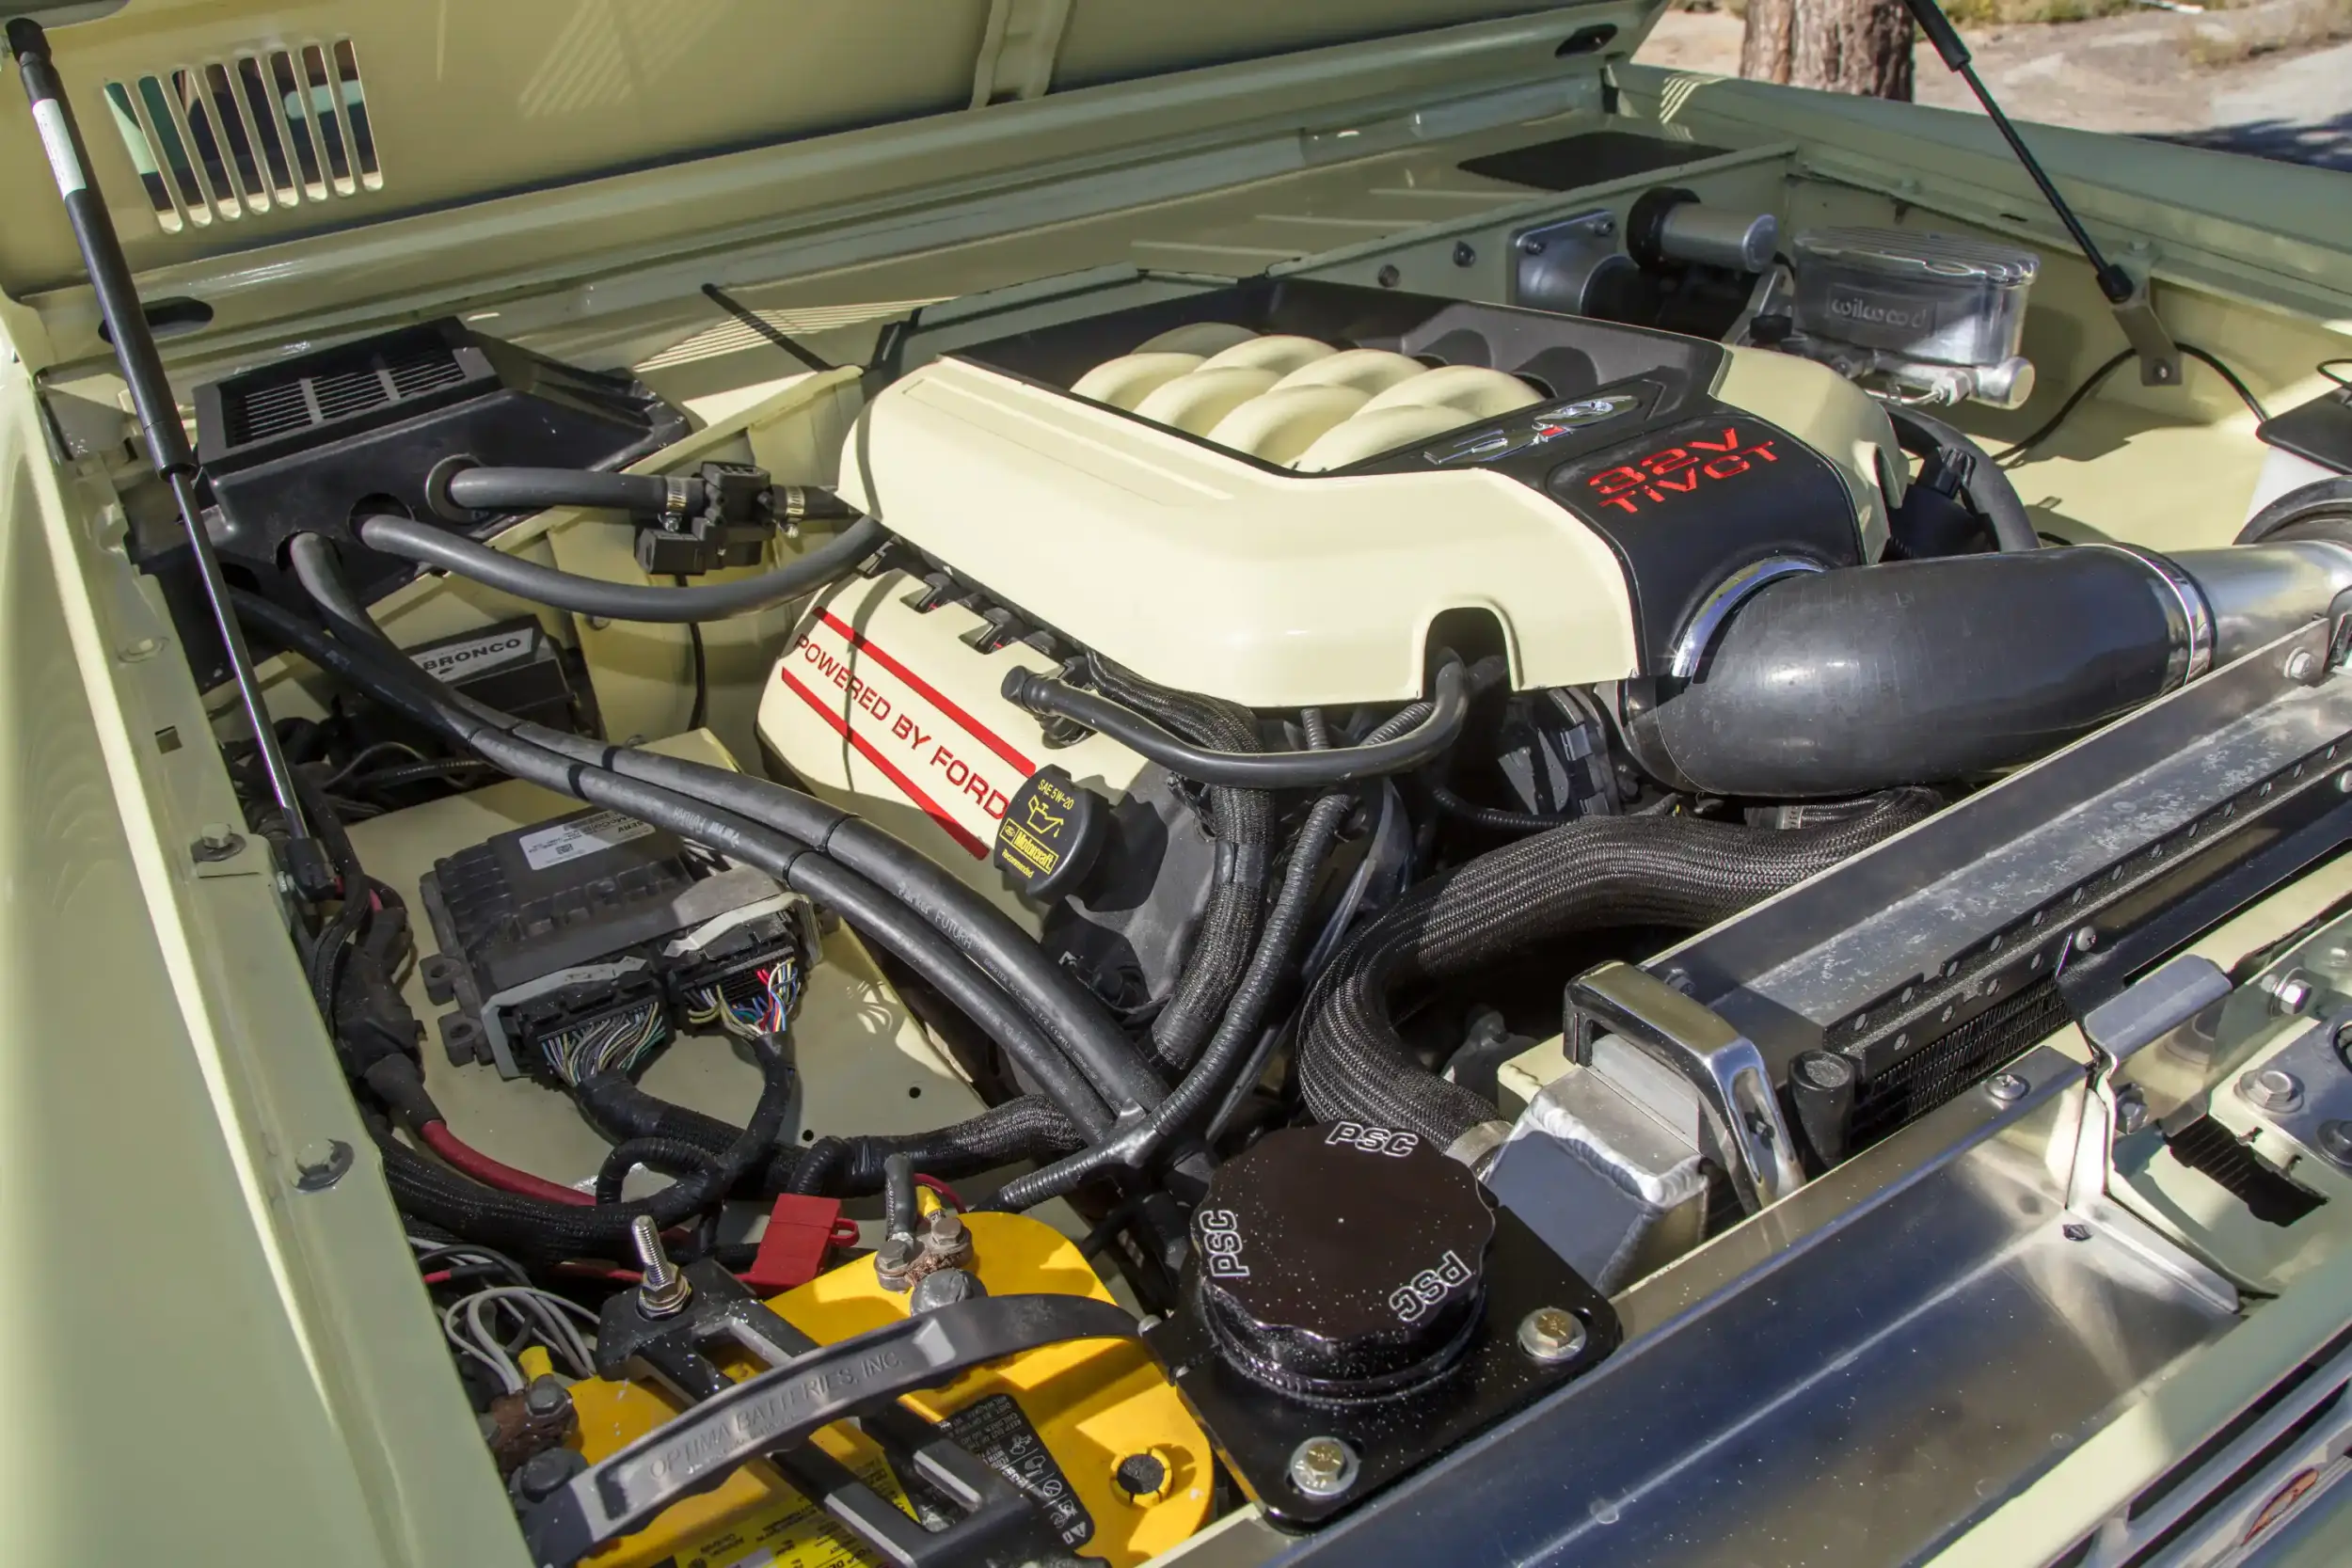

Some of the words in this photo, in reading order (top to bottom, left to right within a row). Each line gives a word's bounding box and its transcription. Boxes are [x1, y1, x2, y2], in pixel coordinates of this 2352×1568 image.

[1830, 297, 1928, 328] wilwood
[1588, 427, 1740, 495] 32V
[423, 639, 520, 670] BRONCO
[794, 634, 891, 721] POWERED
[892, 712, 931, 750] BY
[931, 747, 1009, 818] FORD
[1038, 779, 1053, 796] SAE
[1051, 788, 1074, 811] 5W-20
[1002, 848, 1034, 879] Recommended
[1013, 832, 1055, 871] Motorcraft
[1326, 1120, 1419, 1158] PSC
[1199, 1209, 1250, 1278] PSC
[1388, 1250, 1472, 1323] PSC
[648, 1425, 731, 1480] OPTIMA
[860, 1351, 903, 1378] INC.
